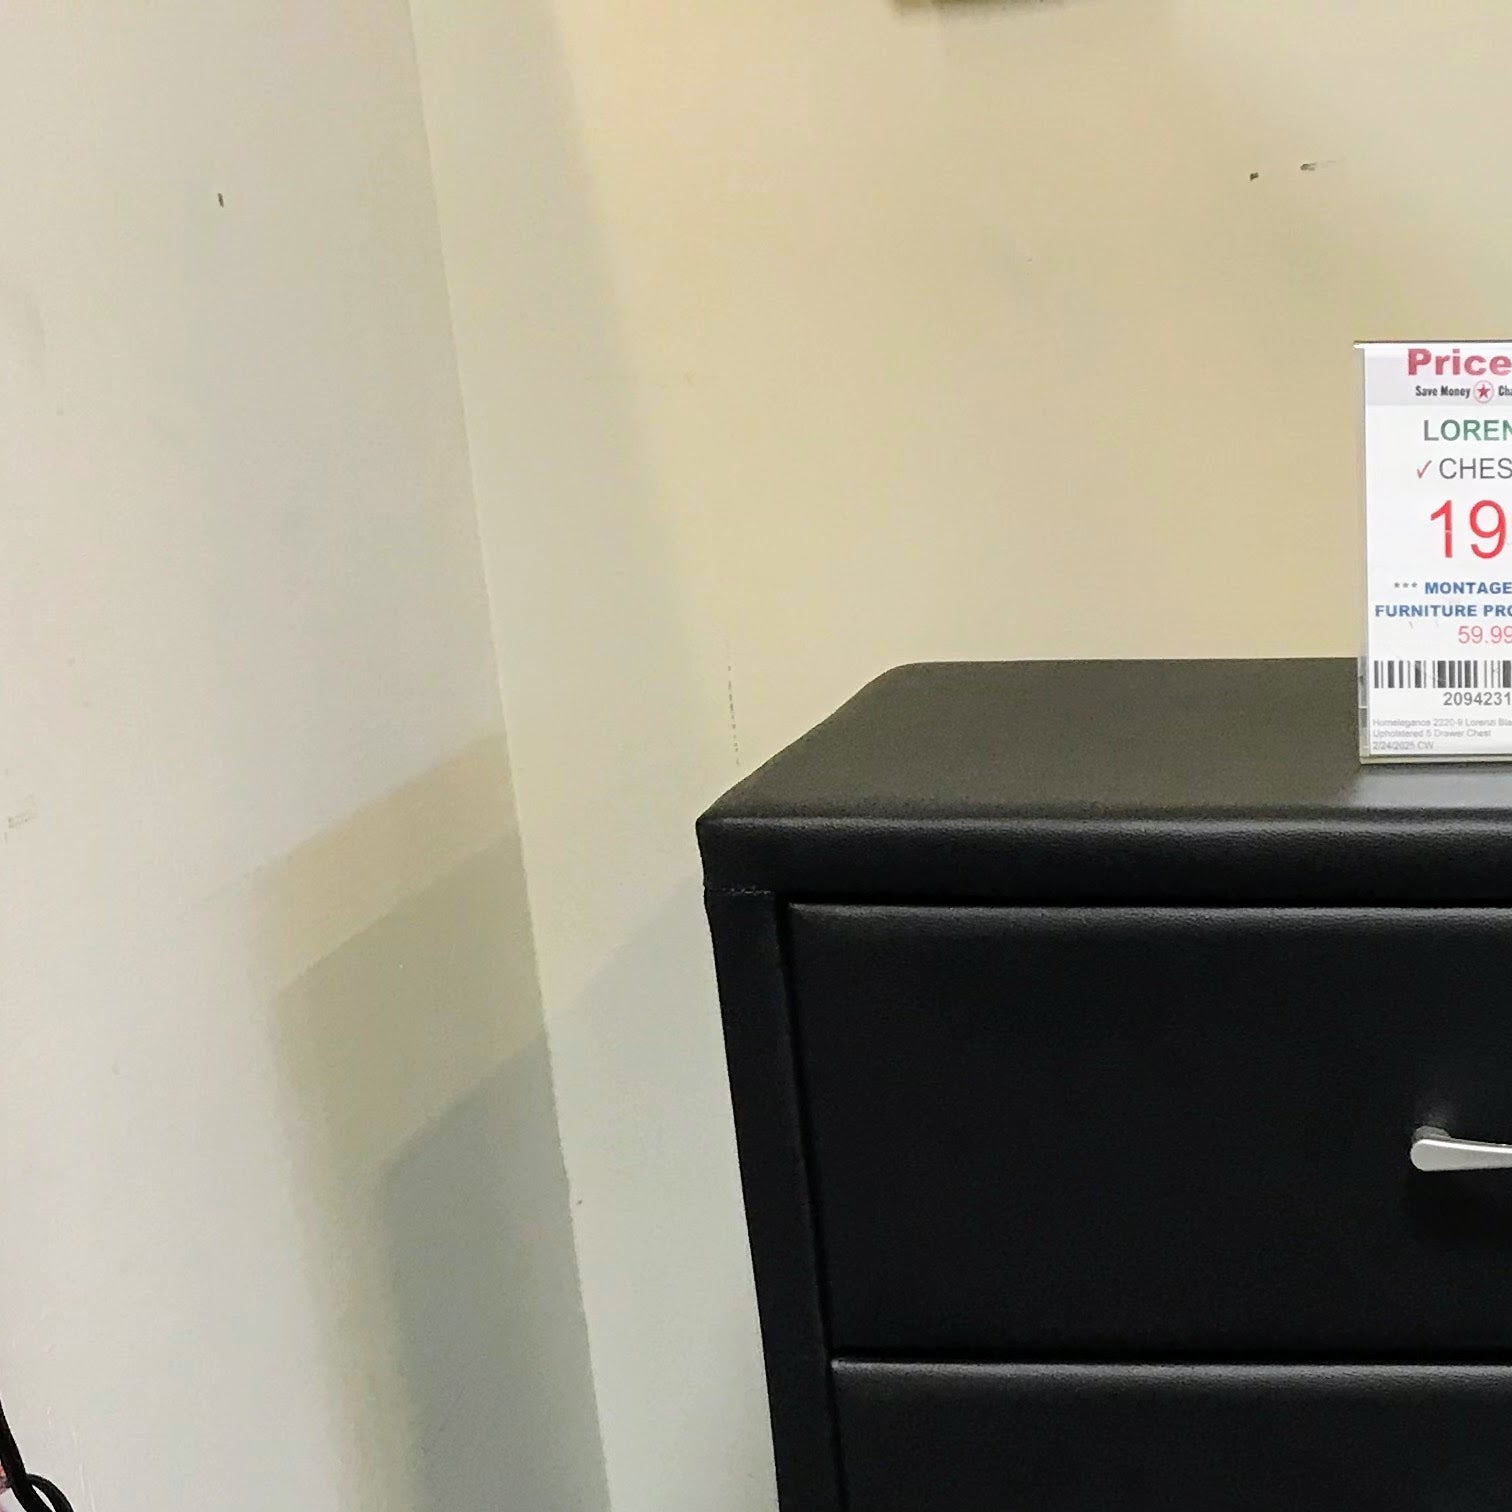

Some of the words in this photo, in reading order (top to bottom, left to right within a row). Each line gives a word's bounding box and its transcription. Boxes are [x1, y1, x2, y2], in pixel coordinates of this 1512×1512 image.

[1415, 386, 1438, 397] Save
[1441, 385, 1471, 399] Money
[1424, 582, 1512, 594] MONTAGE
[1375, 605, 1477, 617] FURNITURE
